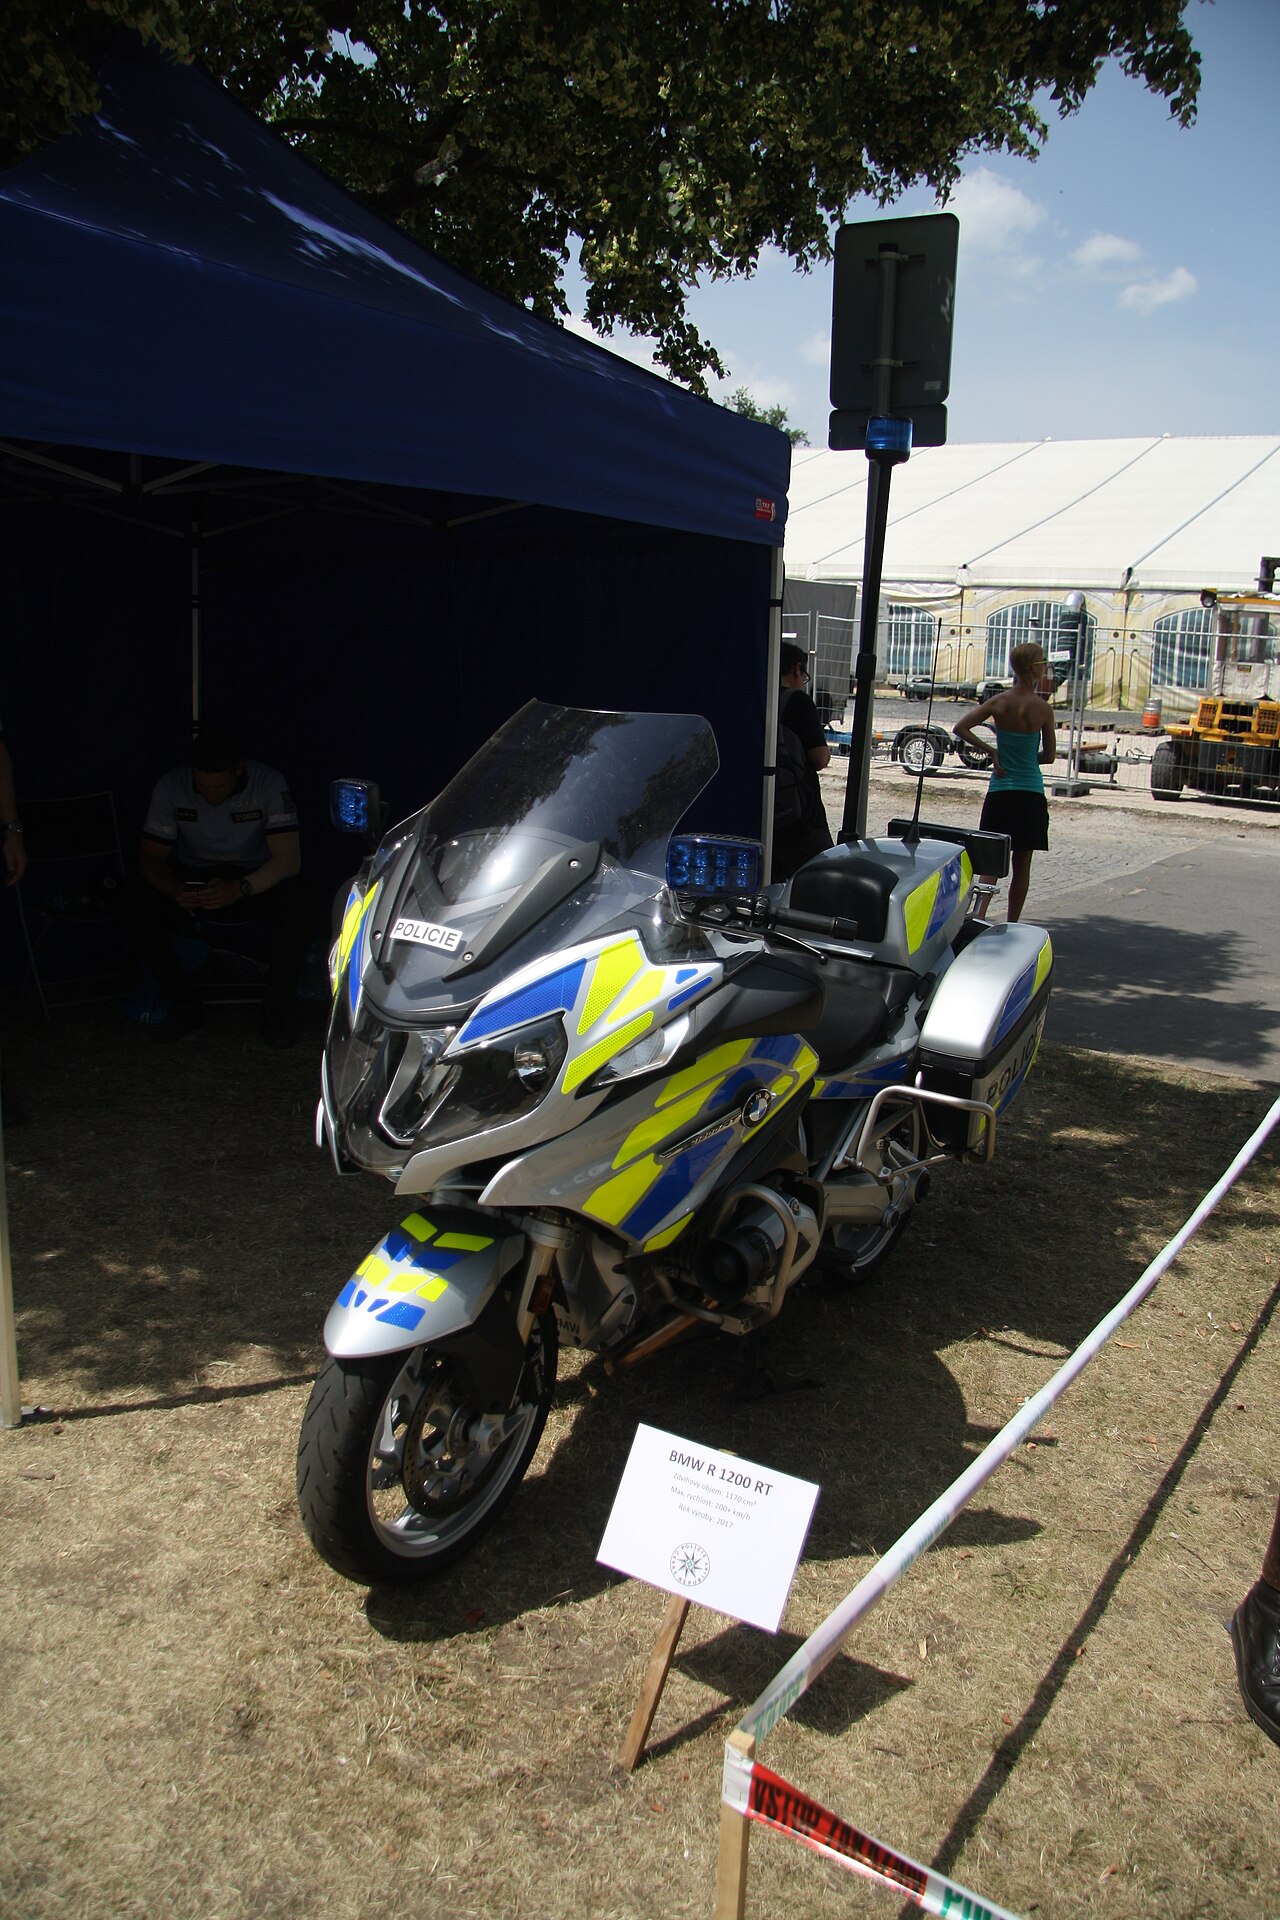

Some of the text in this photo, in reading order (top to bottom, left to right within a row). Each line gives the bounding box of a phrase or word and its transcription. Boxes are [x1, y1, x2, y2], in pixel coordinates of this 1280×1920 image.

[393, 922, 458, 948] POLICIE
[669, 1450, 773, 1496] BMW R 1200 RT
[670, 1485, 685, 1496] Max.
[715, 1502, 731, 1513] 200+
[732, 1508, 751, 1521] km/h
[725, 1491, 742, 1503] 1170
[678, 1502, 690, 1513] Rok
[716, 1517, 734, 1528] 2017
